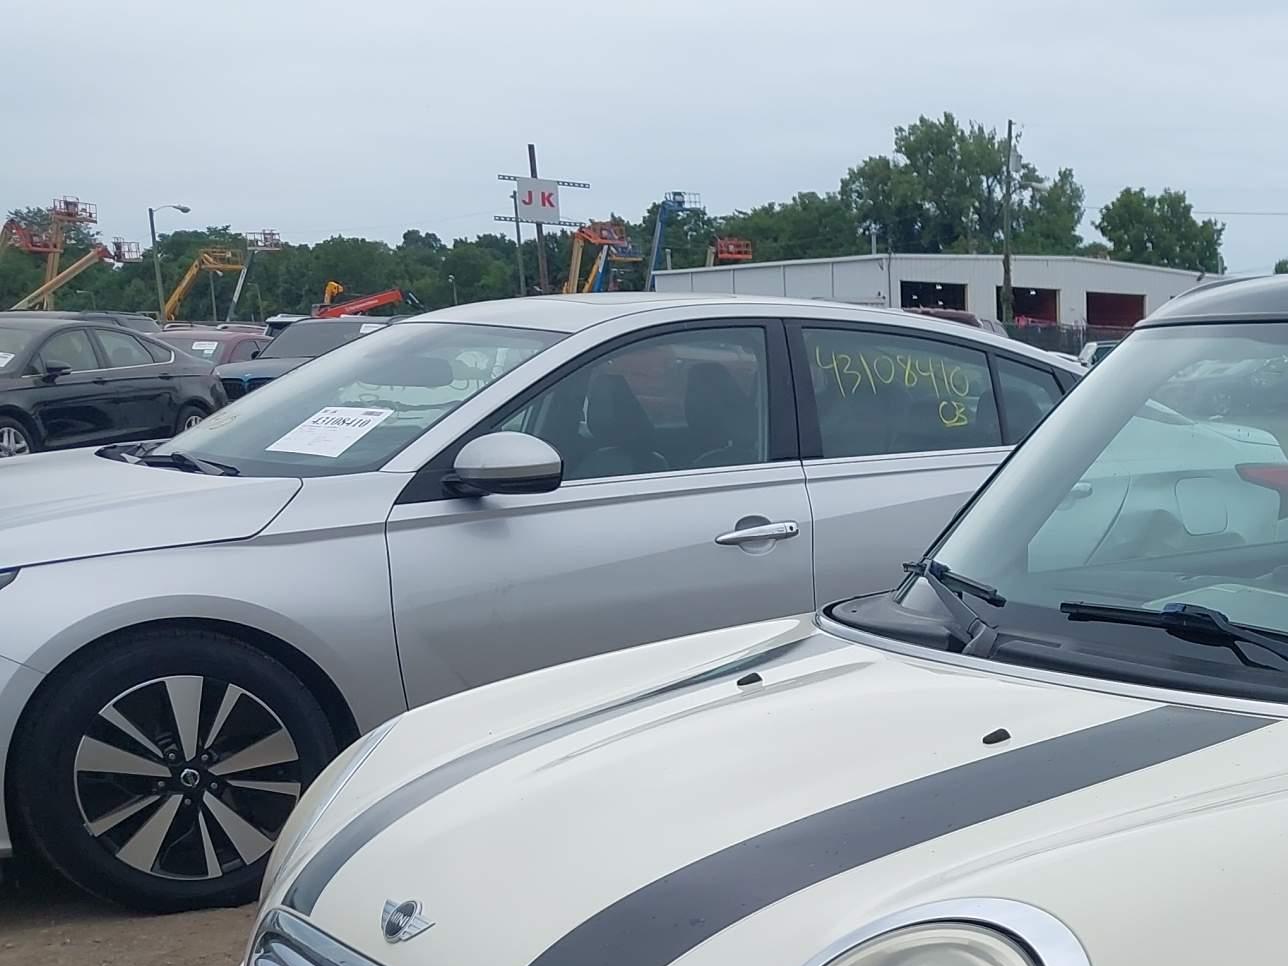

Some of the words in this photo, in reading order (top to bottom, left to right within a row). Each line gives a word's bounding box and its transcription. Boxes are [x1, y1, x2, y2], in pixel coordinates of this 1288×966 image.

[522, 190, 533, 206] J
[541, 191, 555, 208] K
[815, 346, 969, 398] 43108410
[312, 415, 373, 428] 43108410
